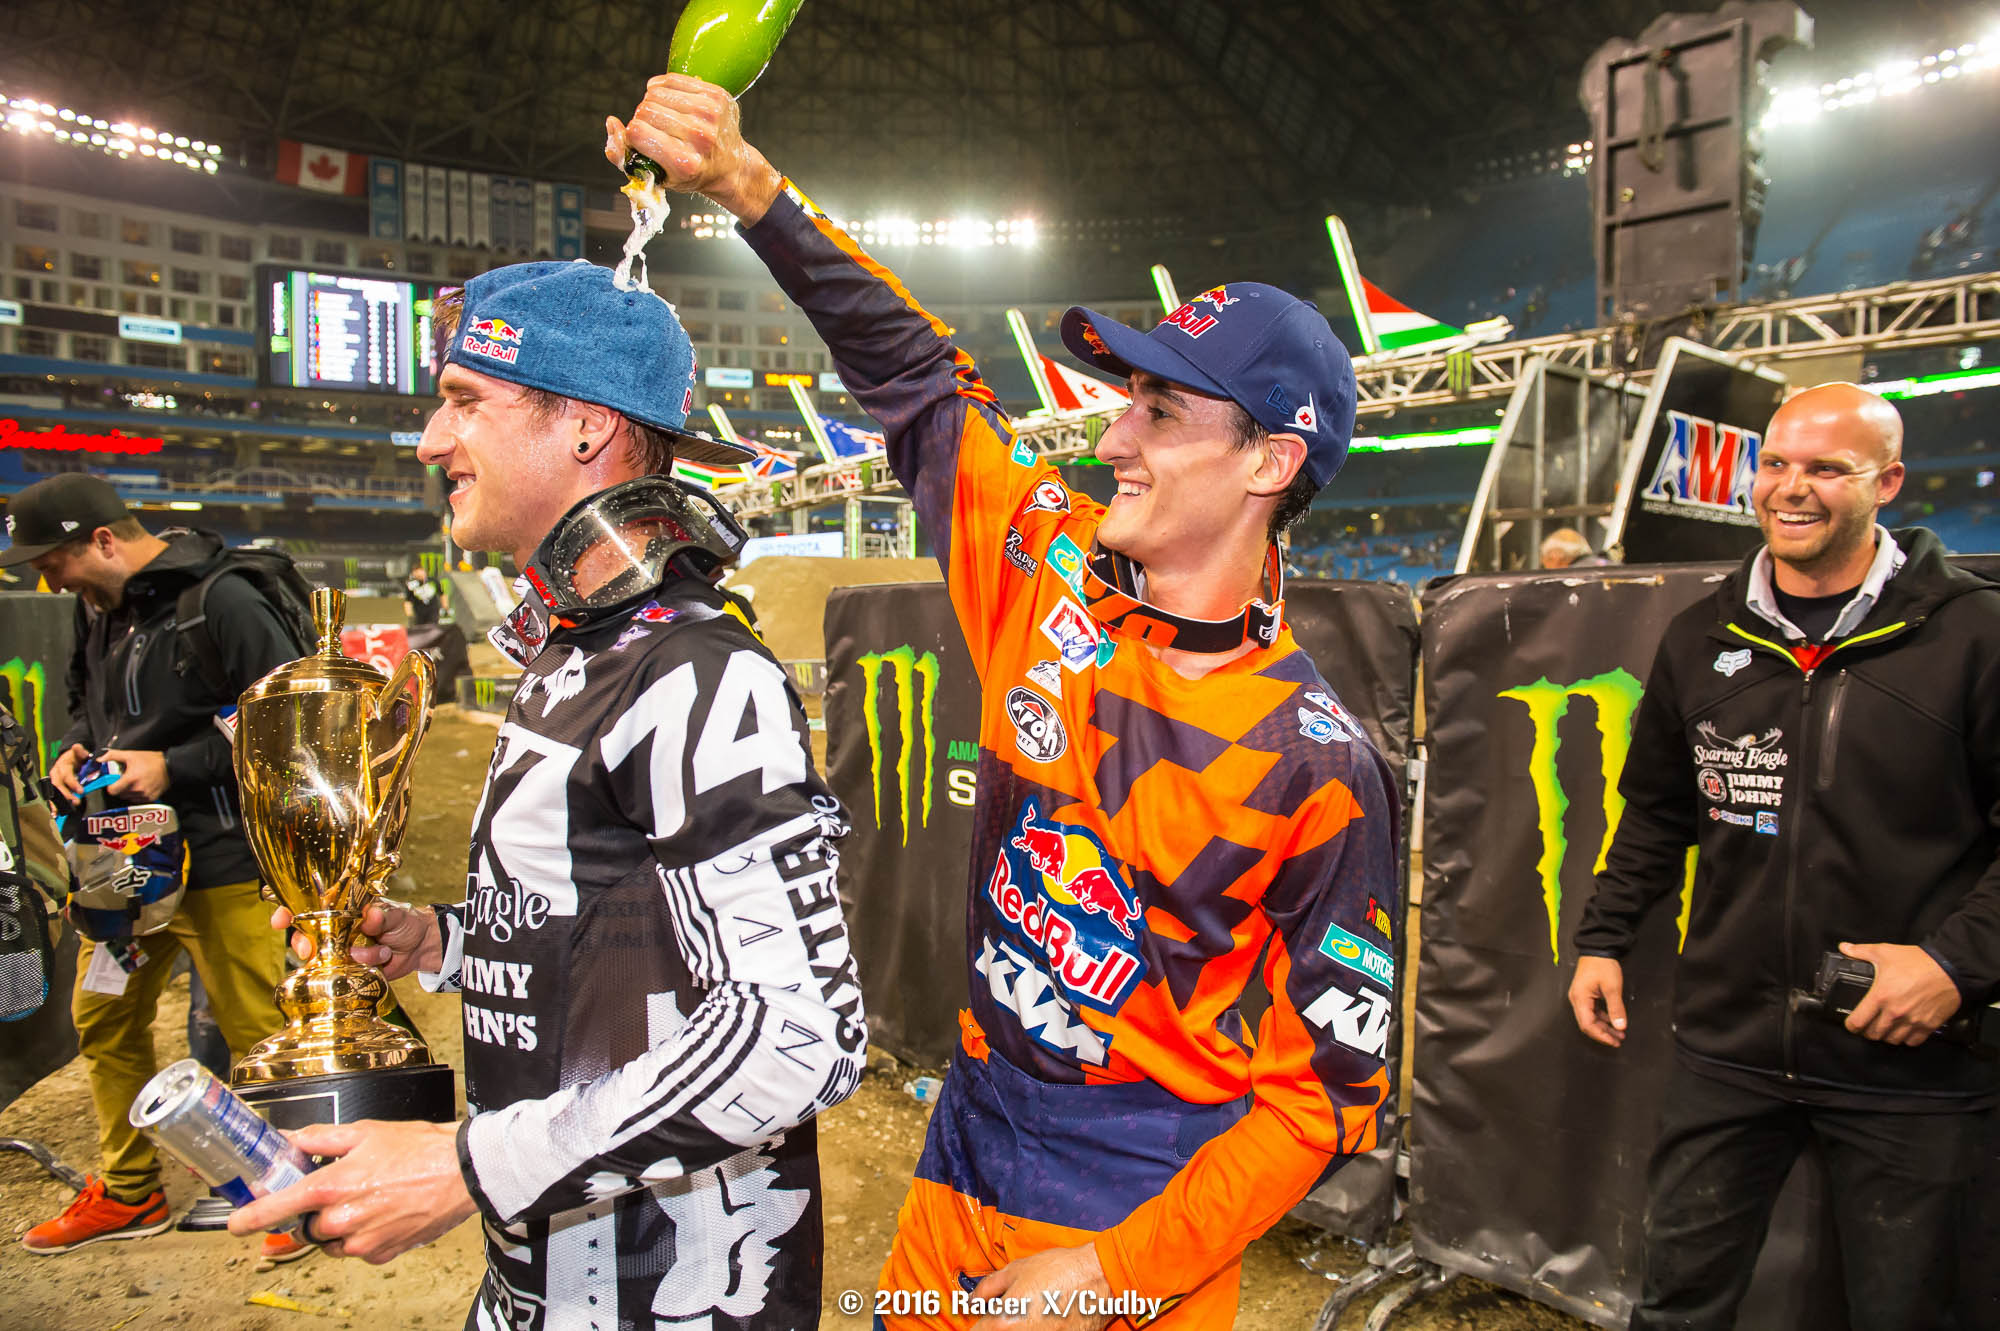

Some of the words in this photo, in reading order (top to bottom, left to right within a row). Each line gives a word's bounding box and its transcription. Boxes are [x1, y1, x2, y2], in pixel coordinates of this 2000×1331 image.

[463, 335, 492, 357] Red
[490, 343, 519, 365] Bull
[1641, 409, 1762, 517] AMA
[600, 654, 808, 840] 74
[1694, 744, 1745, 768] Soaring
[1744, 747, 1789, 771] Eagle
[1726, 773, 1784, 800] JIMMY
[1729, 788, 1783, 807] JOHN'S
[463, 872, 551, 943] Eagle
[987, 847, 1049, 949] Red
[1043, 907, 1141, 1007] Bull
